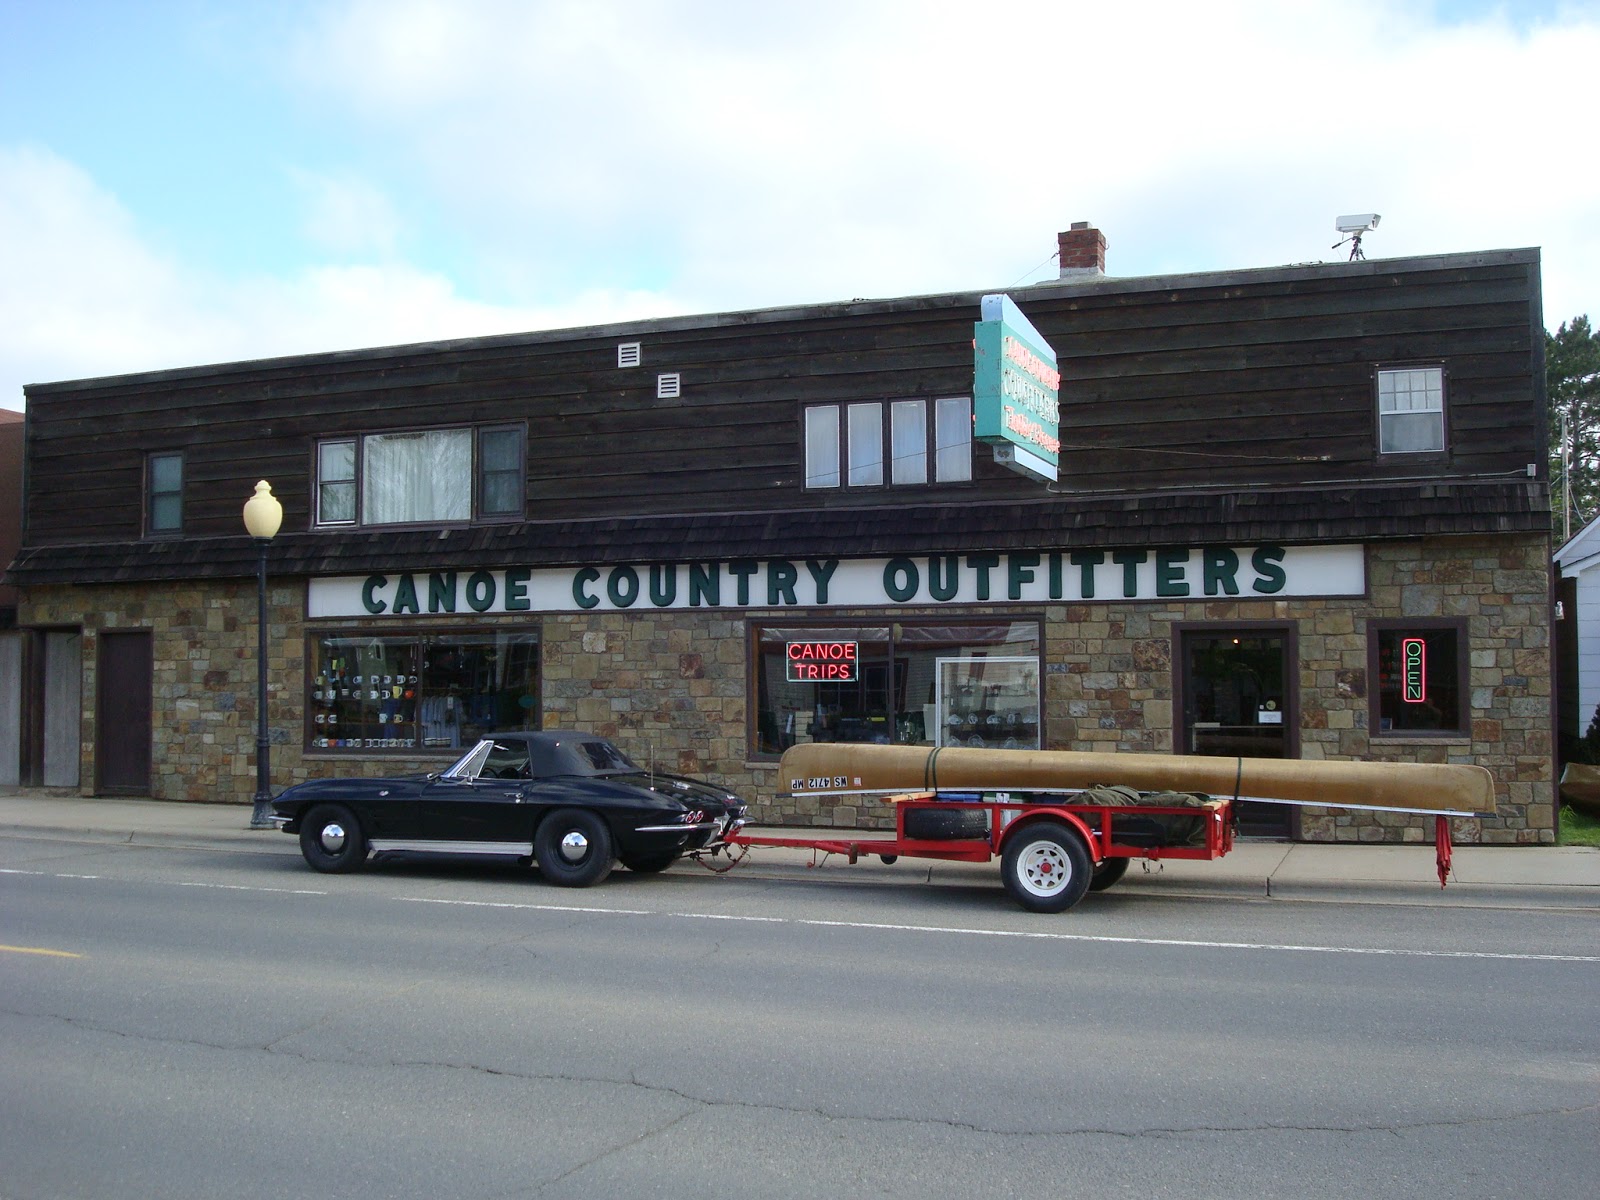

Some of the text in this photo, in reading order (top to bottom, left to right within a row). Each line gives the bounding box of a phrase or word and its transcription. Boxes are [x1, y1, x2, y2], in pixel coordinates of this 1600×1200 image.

[362, 545, 1287, 614] CANOE COUNTRY OUTFITTERS
[788, 643, 855, 660] CANOE
[795, 664, 850, 679] TRIPS
[1407, 643, 1421, 698] OPEN
[792, 777, 847, 789] WS 4712 MP
